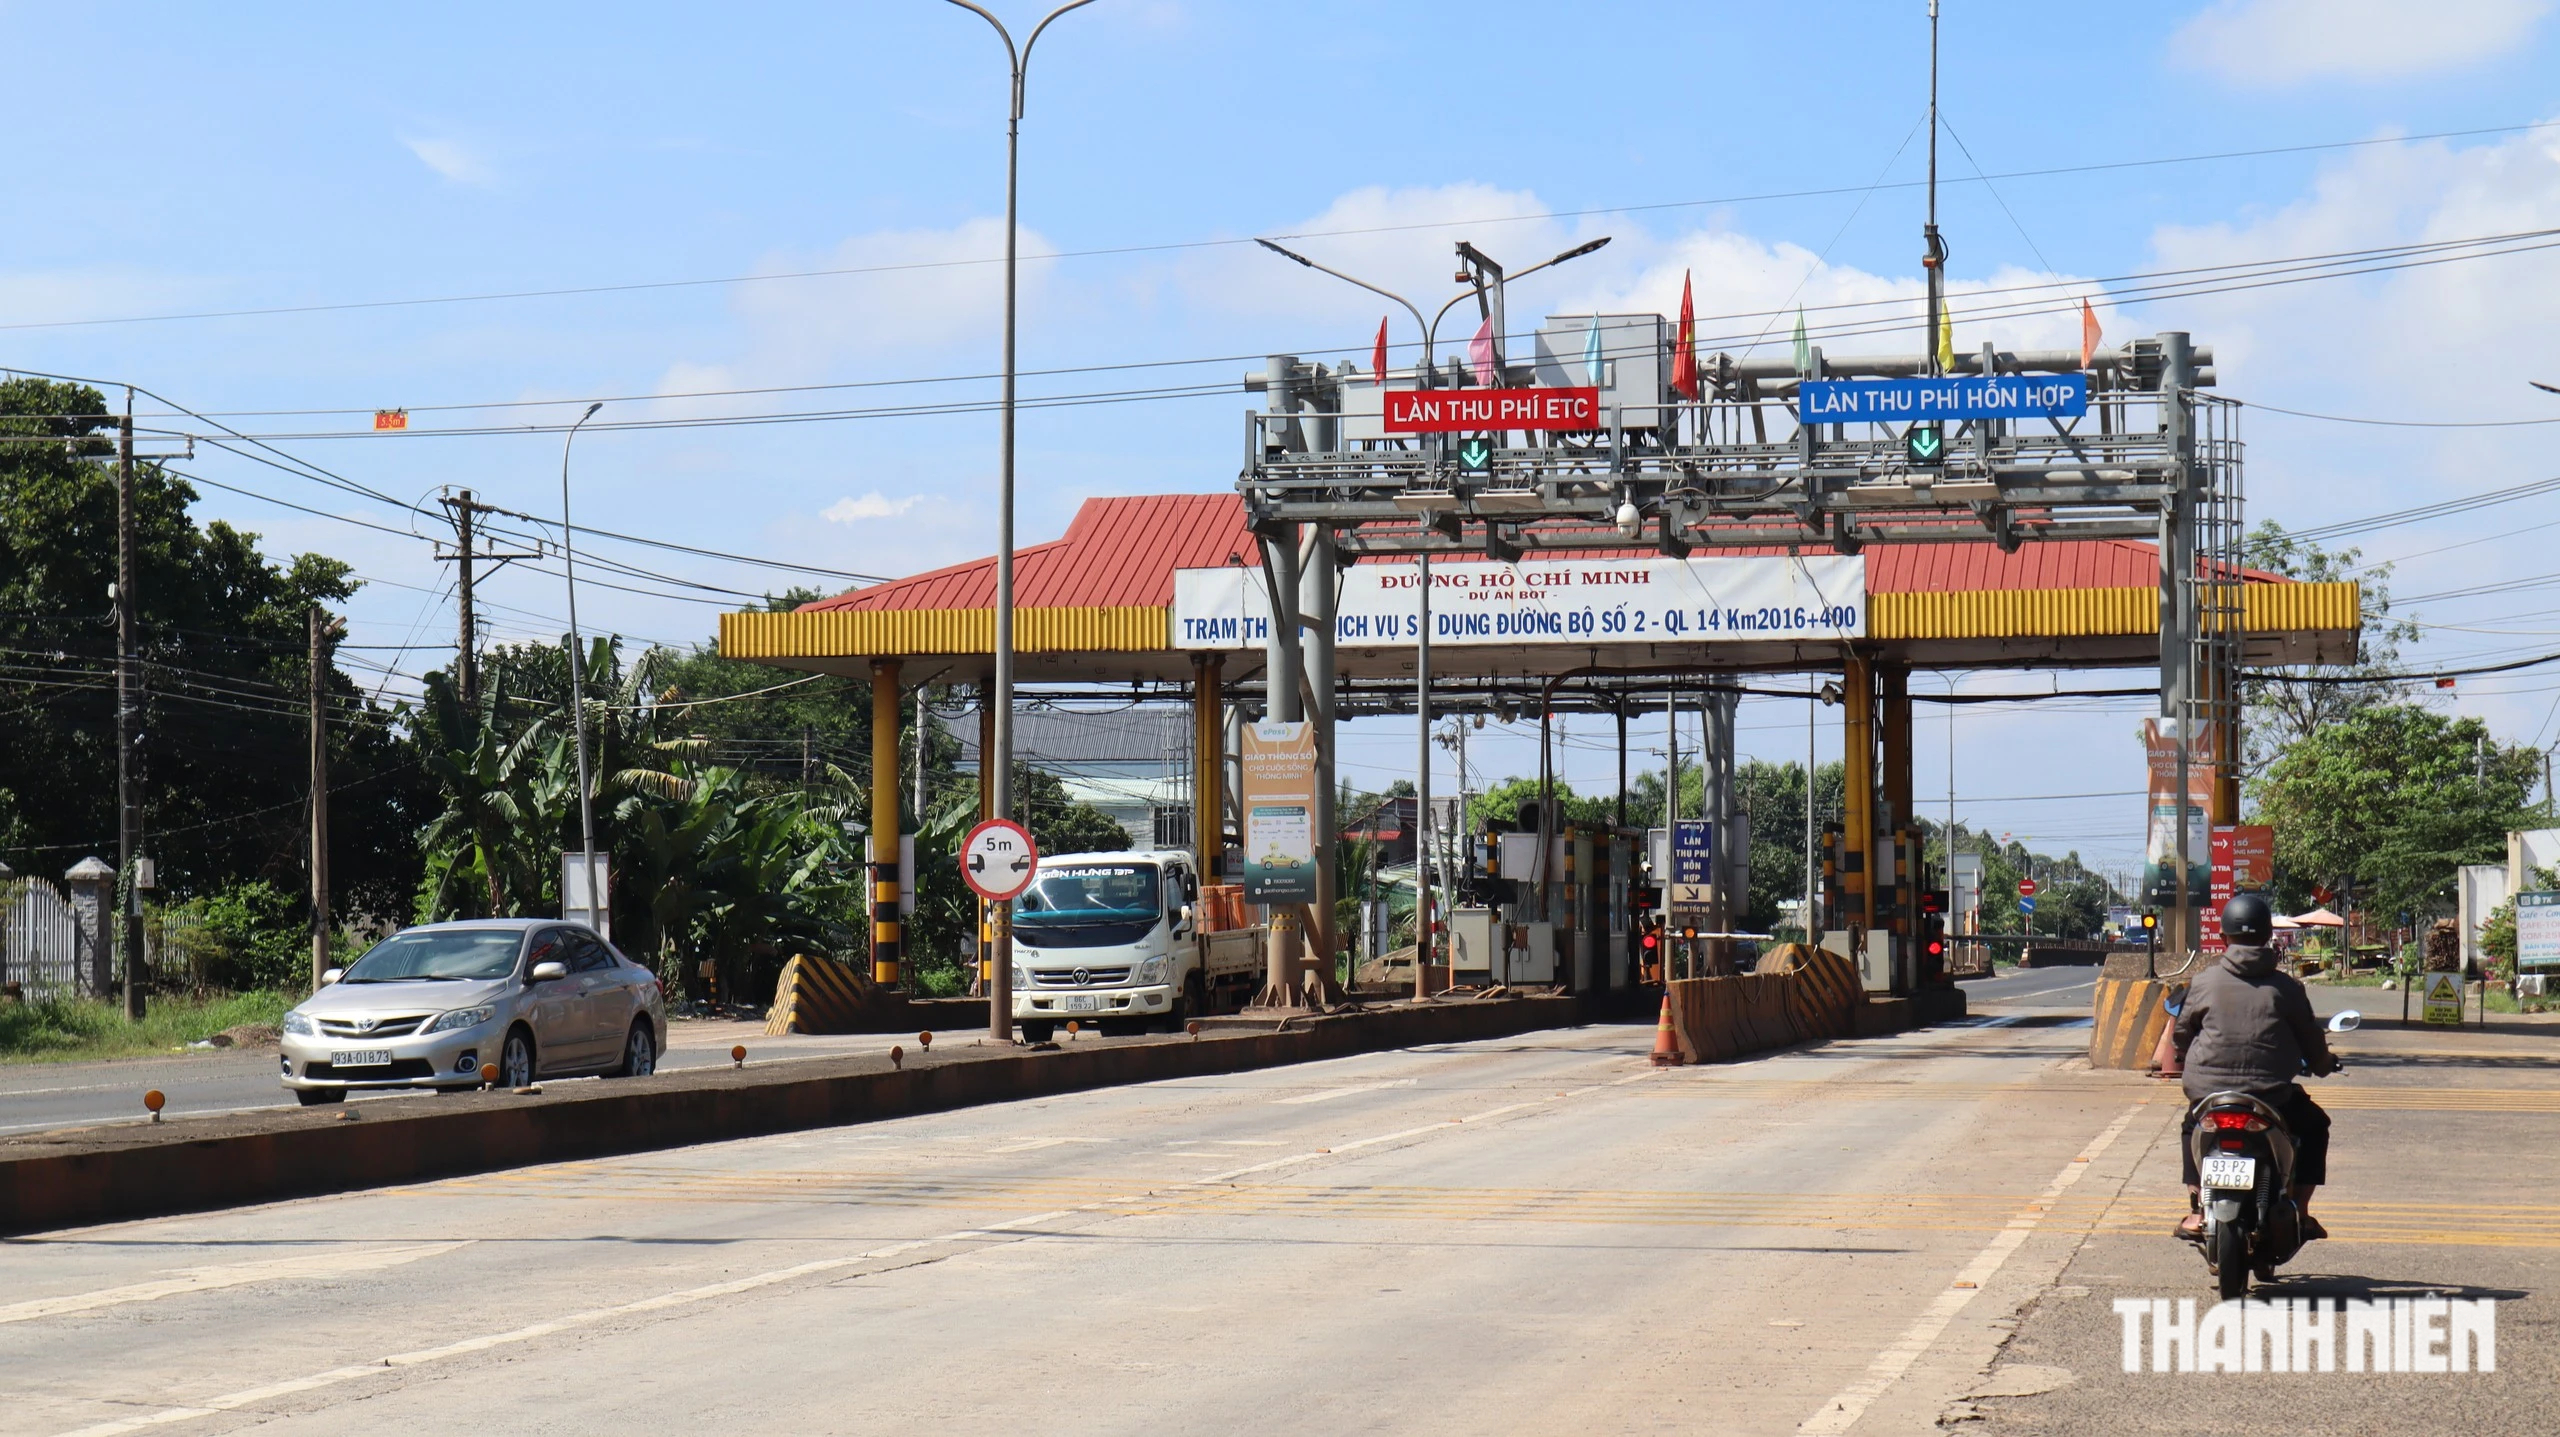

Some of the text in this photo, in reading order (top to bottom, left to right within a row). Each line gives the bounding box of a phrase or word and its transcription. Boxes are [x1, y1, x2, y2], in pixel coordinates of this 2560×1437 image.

[1809, 379, 2075, 413] LÀN THU PHÍ HỖN HỢP
[1393, 394, 1589, 423] LÀN THU PHÍ ETC
[1480, 566, 1515, 587] HỒ
[1525, 569, 1572, 586] CHÍ
[1581, 570, 1651, 585] MINH
[1468, 590, 1488, 602] DỰ
[1494, 588, 1514, 600] ÁN
[1519, 590, 1548, 600] BOT
[1183, 617, 1237, 643] TRẠM
[1243, 617, 1268, 639] TH
[1337, 615, 1368, 642] ỊCH
[1375, 614, 1399, 640] VỤ
[1406, 610, 1433, 636] S
[1438, 612, 1490, 640] DỤNG
[1496, 606, 1562, 635] ĐƯỜNG
[1569, 605, 1595, 637] BỘ
[1601, 601, 1629, 634] SỐ
[1633, 610, 1646, 632] 2
[1664, 609, 1689, 636] QL
[1697, 608, 1720, 631] 14
[1727, 605, 1857, 631] Km2016+400
[1244, 748, 1312, 761] GIAO THÔNG SỐ
[1248, 764, 1265, 772] CHO
[1256, 772, 1303, 780] THÔNG MINH
[1675, 847, 1709, 858] THU PHÍ
